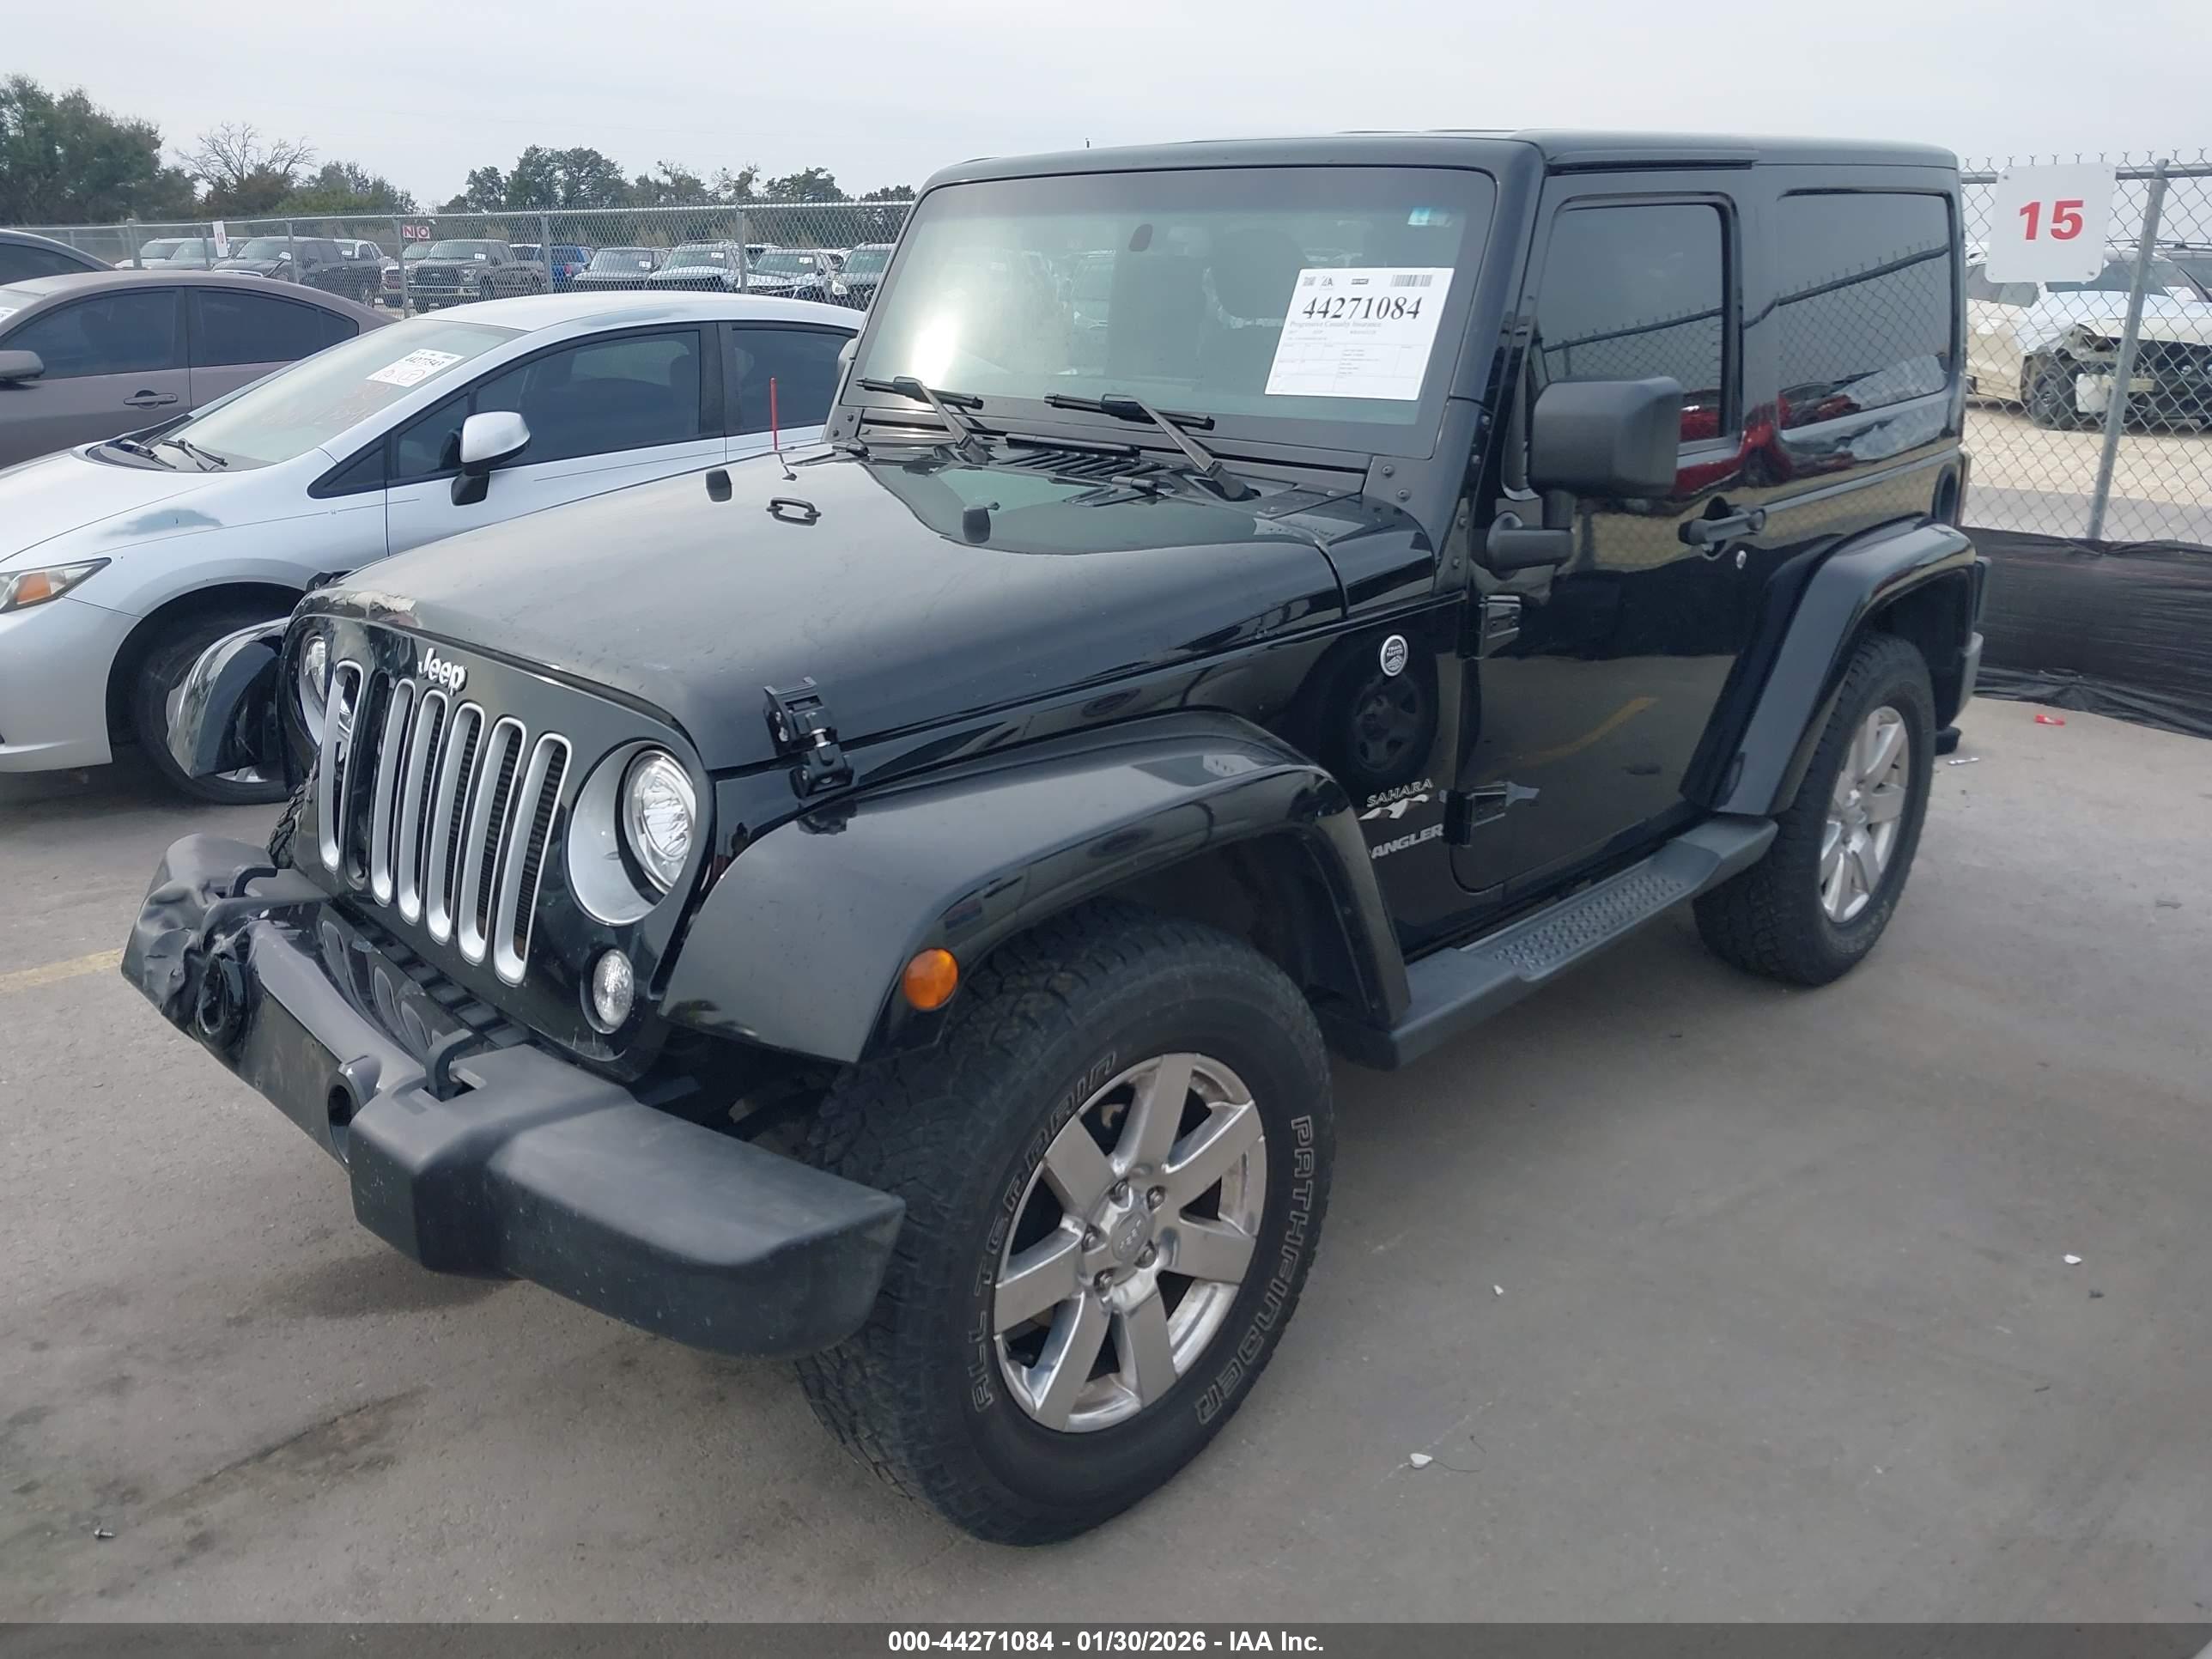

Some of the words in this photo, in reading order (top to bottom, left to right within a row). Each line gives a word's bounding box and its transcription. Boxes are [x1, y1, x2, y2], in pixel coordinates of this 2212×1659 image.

[404, 226, 428, 238] NO
[2020, 199, 2084, 240] 15
[1302, 296, 1422, 320] 44271084
[417, 647, 467, 696] Jeep
[1366, 778, 1433, 808] SAHARA
[1370, 823, 1444, 860] ANGLER
[974, 1050, 1116, 1297] TERRAIN
[1194, 1115, 1315, 1425] PATHFINDER
[968, 1310, 994, 1413] ALL
